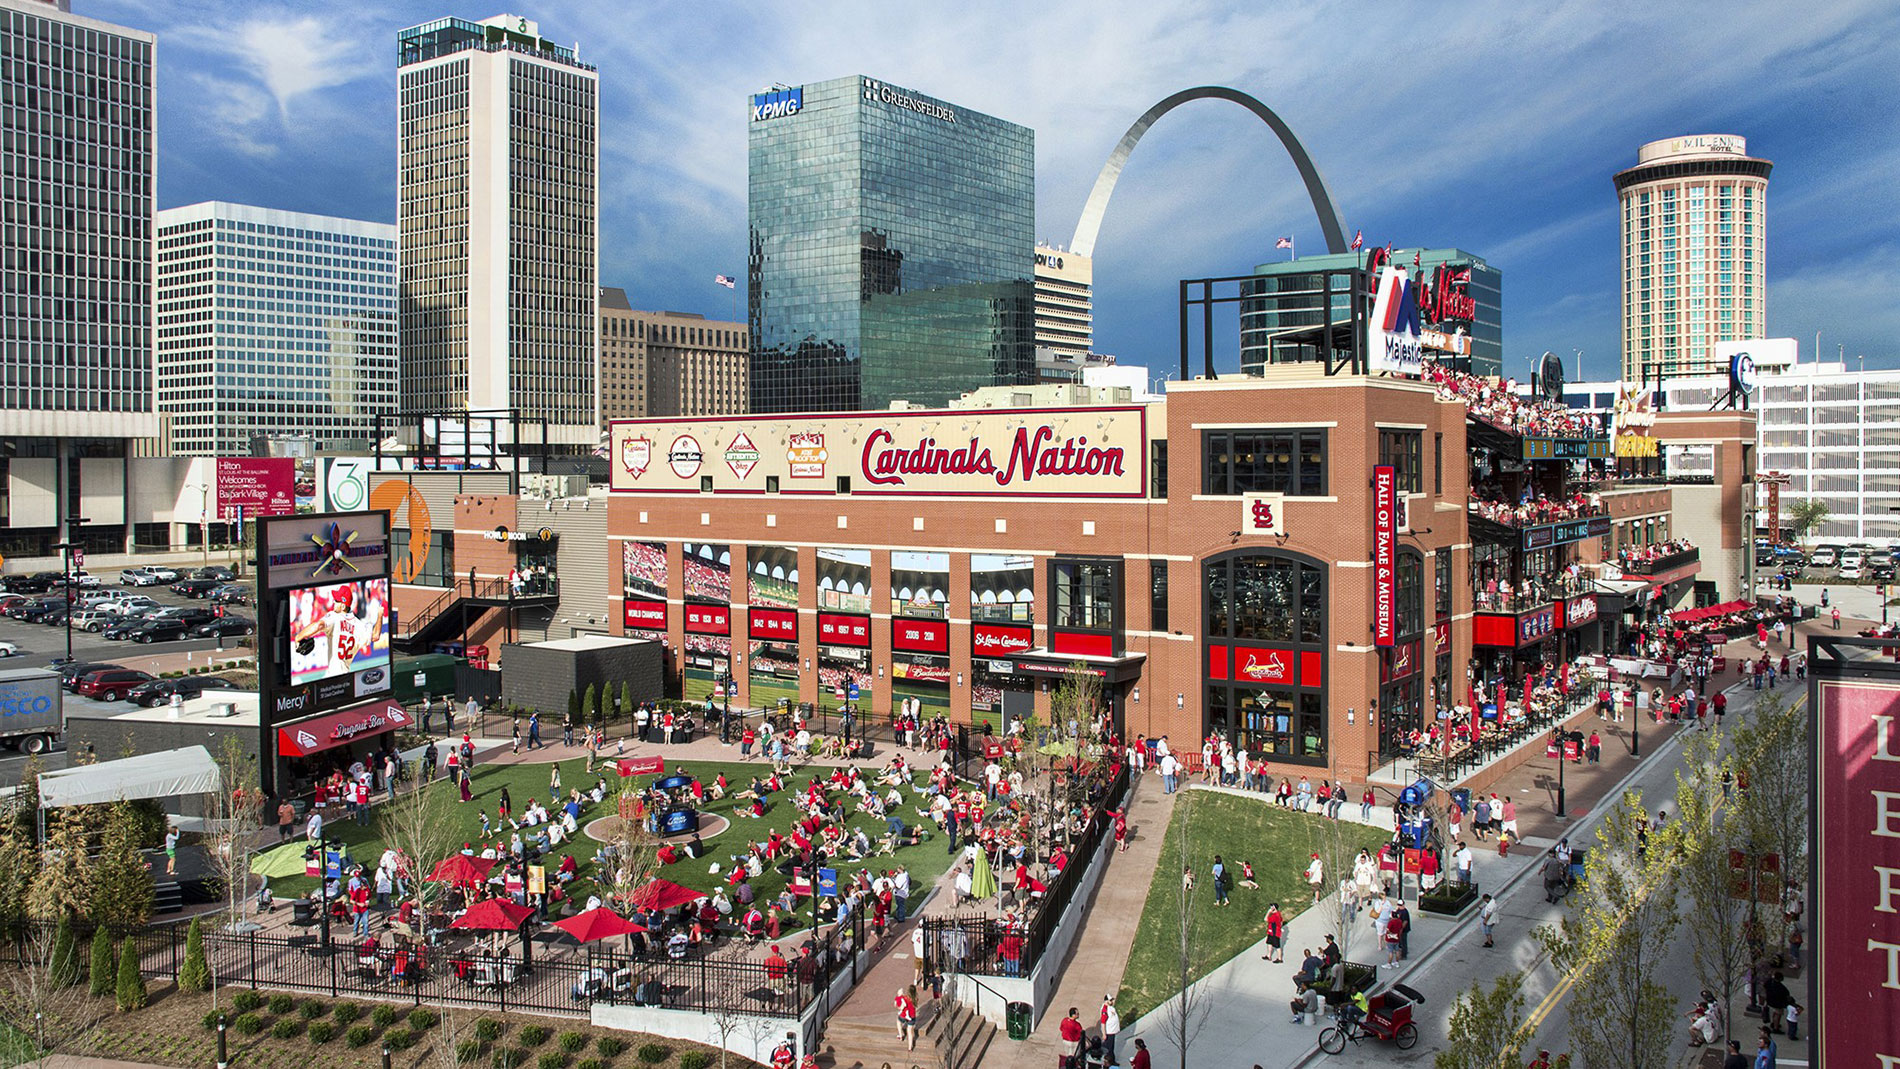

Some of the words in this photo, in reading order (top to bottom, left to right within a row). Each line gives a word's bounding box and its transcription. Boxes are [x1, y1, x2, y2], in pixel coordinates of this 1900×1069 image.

[752, 98, 797, 121] KPMG
[881, 86, 956, 123] GREENSFELDER
[1385, 334, 1422, 368] Majestic
[861, 427, 998, 486] Cardinals
[995, 425, 1125, 486] Nation
[218, 462, 240, 470] Hilton
[218, 475, 257, 484] Welcomes
[246, 489, 268, 500] Village
[1378, 473, 1390, 508] HALL
[1378, 510, 1388, 528] OF
[1378, 530, 1390, 566] FAME
[1378, 567, 1390, 579] &
[628, 609, 641, 619] WORLD
[642, 609, 664, 620] CHAMPIONS
[1378, 582, 1390, 639] MUSEUM
[754, 619, 764, 628] 1942
[768, 620, 778, 629] 1944
[781, 621, 792, 630] 1946
[823, 624, 834, 633] 1964
[838, 625, 849, 635] 1967
[853, 626, 865, 636] 1982
[905, 630, 920, 640] 2006
[924, 631, 934, 641] 2011
[1001, 635, 1029, 648] Cardinals
[338, 635, 356, 660] 52
[277, 696, 305, 712] Mercy
[335, 721, 367, 738] Dugout
[369, 715, 386, 726] Bar
